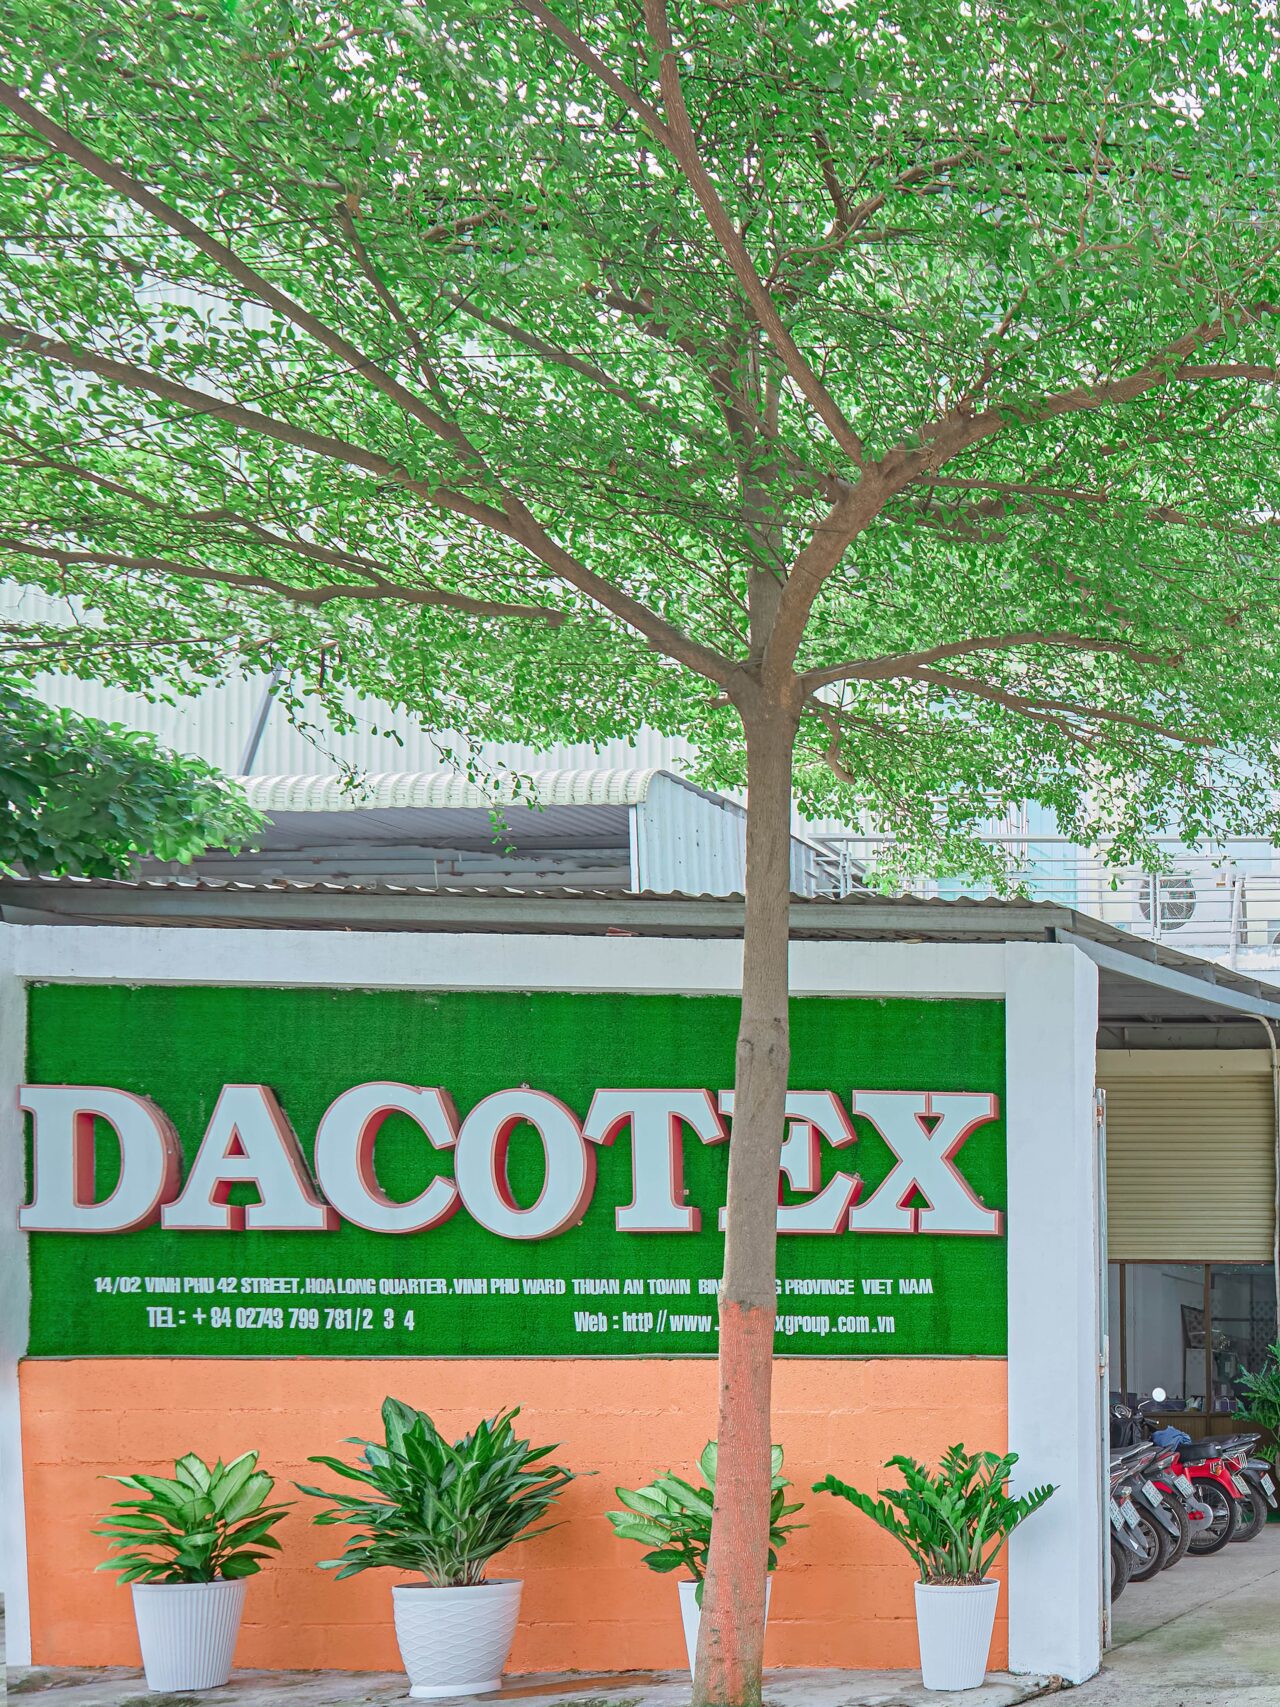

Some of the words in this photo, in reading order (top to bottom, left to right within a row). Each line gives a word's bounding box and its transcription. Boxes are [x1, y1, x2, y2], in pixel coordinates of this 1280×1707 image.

[18, 1081, 1004, 1240] DACOTEX
[94, 1277, 142, 1294] 14/02
[144, 1277, 181, 1293] VINH
[184, 1277, 214, 1293] PHU
[217, 1277, 238, 1293] 42
[453, 1278, 488, 1294] VINH
[490, 1279, 519, 1294] PHU
[522, 1279, 566, 1294] WARD
[572, 1279, 620, 1294] THUAN
[623, 1279, 644, 1294] AN
[647, 1279, 691, 1294] TOWN
[785, 1279, 855, 1295] PROVINCE
[861, 1279, 893, 1294] VIET
[898, 1279, 934, 1294] NAM
[210, 1306, 232, 1328] 84
[235, 1307, 284, 1329] 02743
[288, 1308, 319, 1329] 799
[324, 1307, 374, 1331] 781/2
[383, 1308, 395, 1329] 3
[404, 1310, 415, 1331] 4
[573, 1311, 608, 1332] Web
